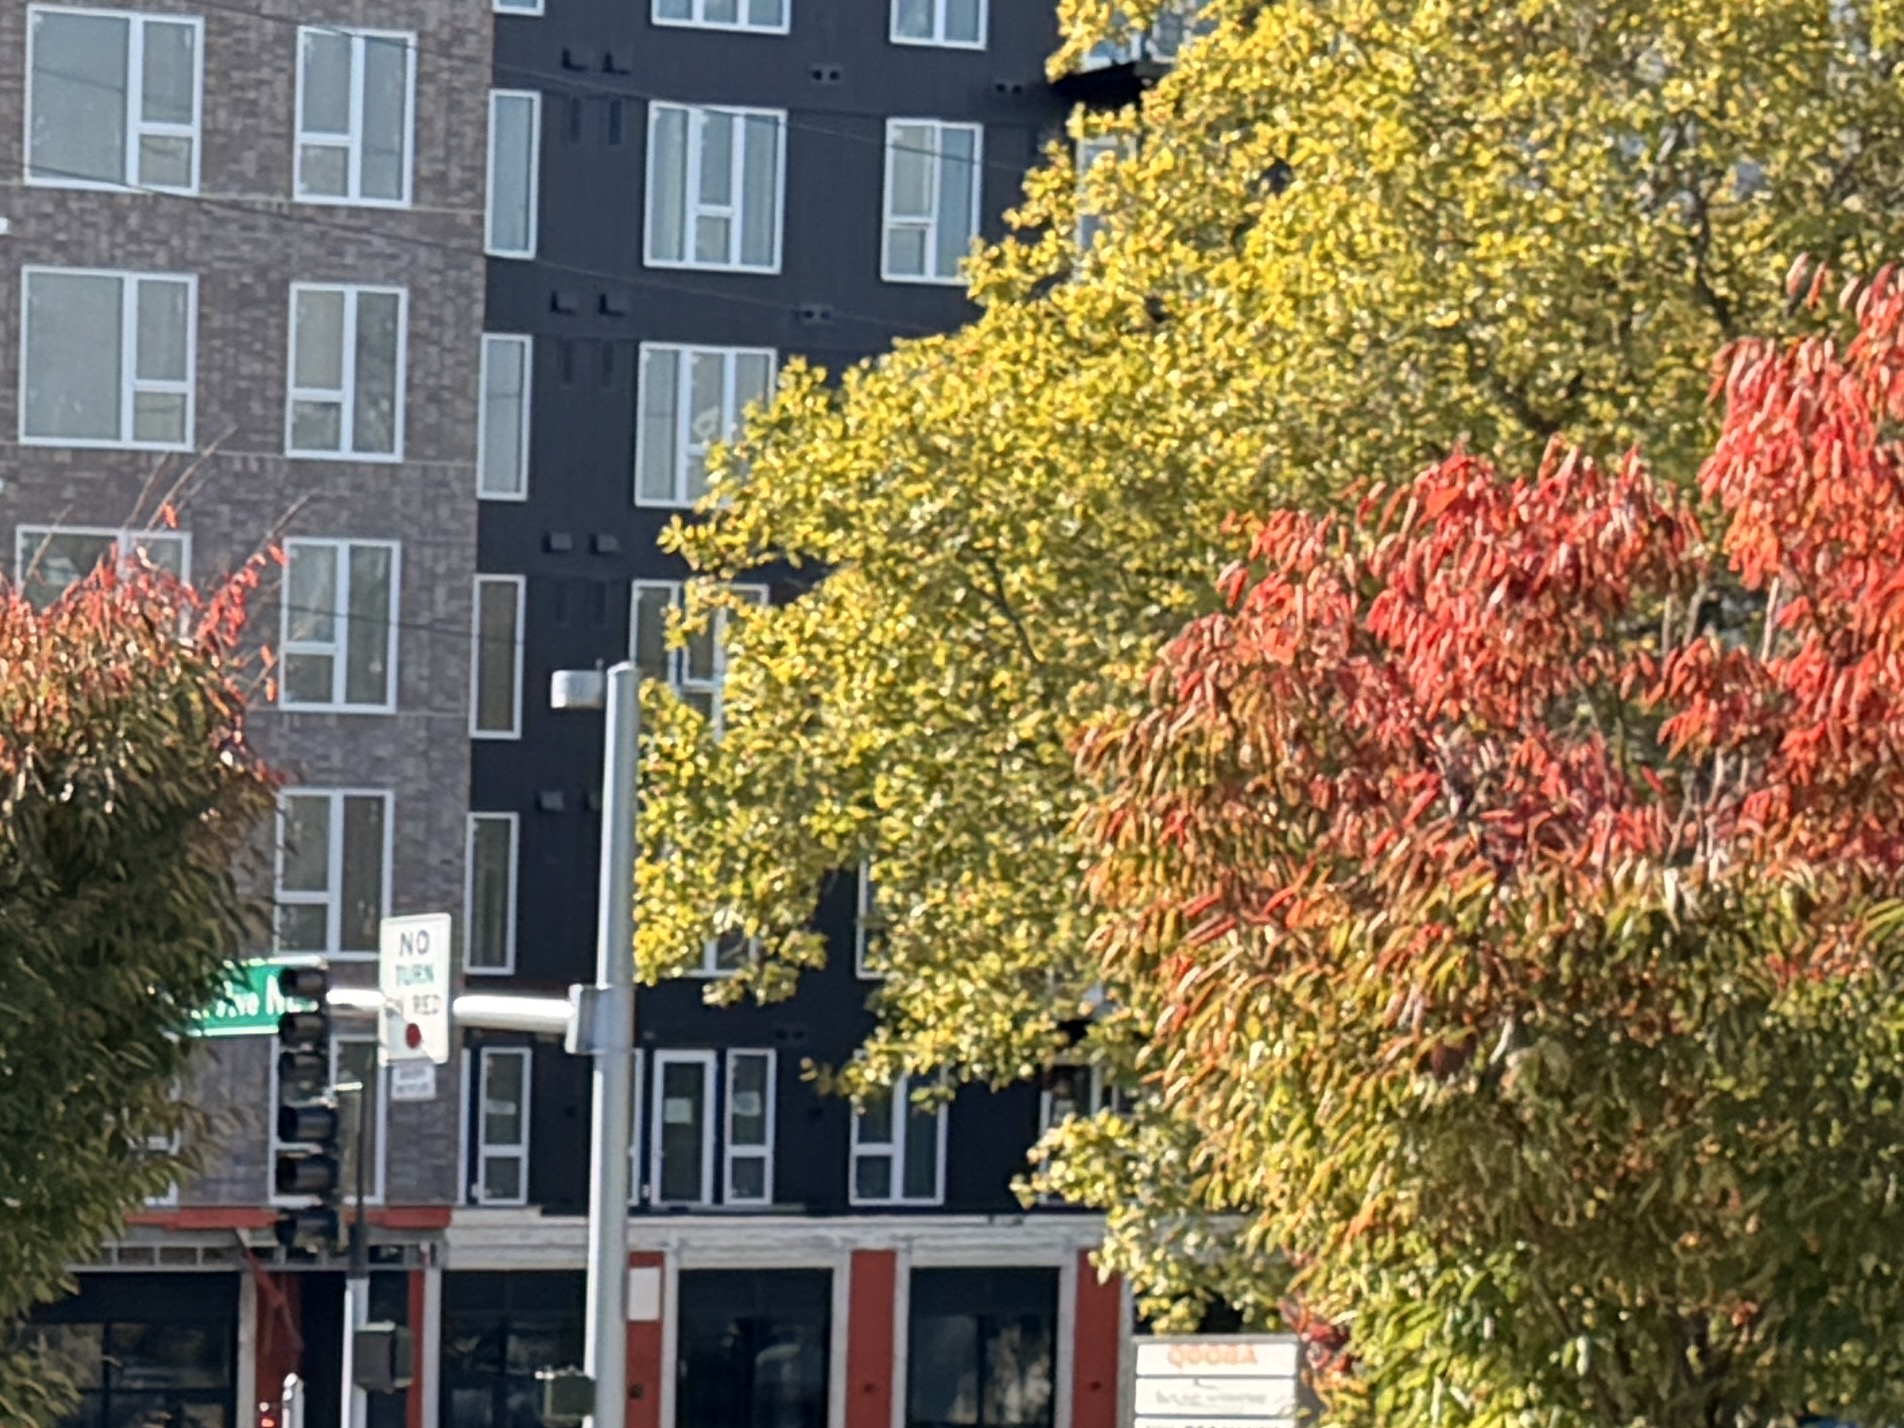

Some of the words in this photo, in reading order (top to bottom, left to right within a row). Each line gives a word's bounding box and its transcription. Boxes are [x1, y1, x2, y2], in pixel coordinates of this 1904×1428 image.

[398, 929, 431, 957] NO
[395, 962, 435, 987] TURN
[411, 993, 442, 1017] RED
